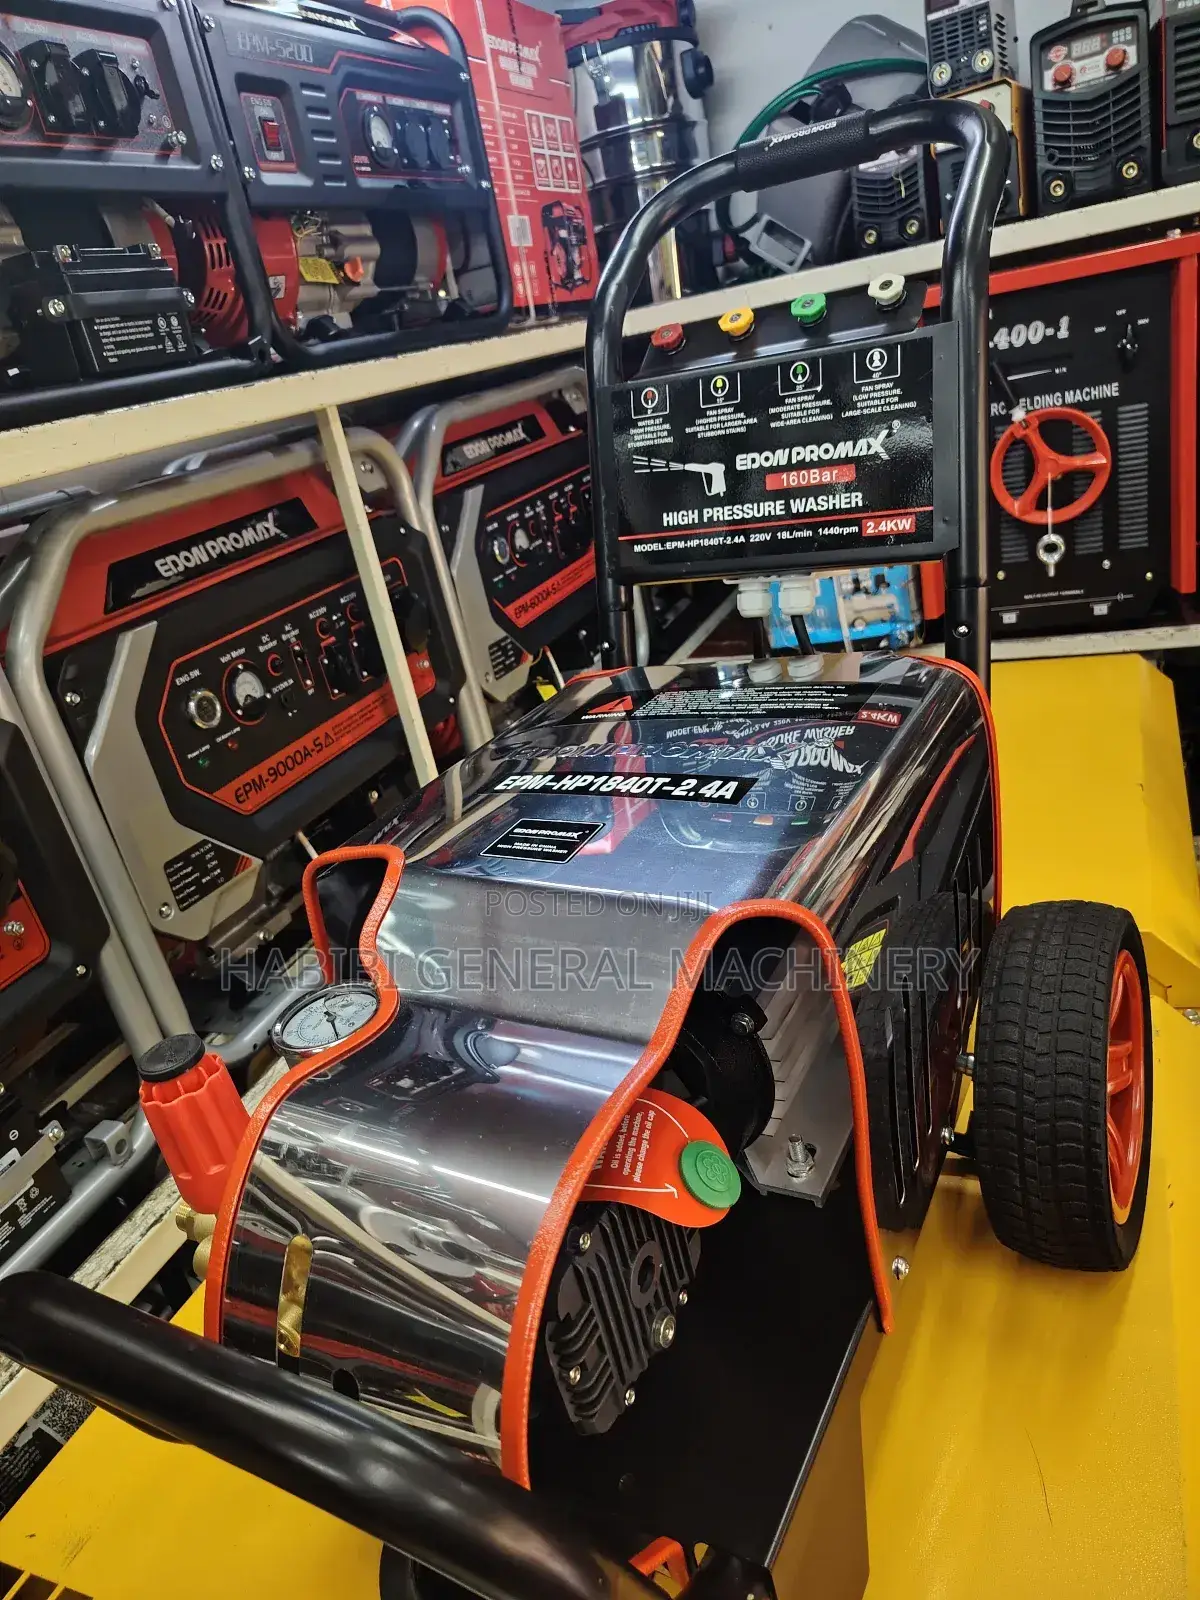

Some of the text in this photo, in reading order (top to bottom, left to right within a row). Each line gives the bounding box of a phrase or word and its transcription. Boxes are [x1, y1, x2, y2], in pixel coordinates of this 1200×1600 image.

[237, 31, 313, 63] EPM-5200
[874, 382, 894, 390] SPRAY
[797, 394, 815, 402] SPRAY
[852, 393, 869, 402] (LOW
[857, 399, 885, 408] SUITABLE
[990, 382, 1120, 417] RC ELDING MACHINE
[717, 407, 734, 415] SPRAY
[768, 403, 801, 414] (MODERATE
[841, 401, 917, 418] LARGE-SCALE CLEANING)
[695, 417, 717, 425] (HIGHER
[770, 414, 833, 428] WIDE-AREA CLEANING)
[781, 411, 807, 419] SUITABLE
[685, 425, 709, 433] SUITABLE
[720, 417, 758, 428] LARGER-AREA
[697, 427, 747, 439] STUBBORN STAINS)
[735, 429, 891, 471] EDON PROMAX
[781, 469, 839, 487] 160Bar
[662, 492, 863, 527] HIGH PRESSURE WASHER
[634, 518, 912, 553] MODEL:EPM-HP1840T-2.4A 220V 18L/min 1440rpm 2.4KW
[154, 511, 288, 578] EDON PROMAX
[261, 633, 271, 643] DC
[220, 647, 246, 664] Volt Meter
[581, 711, 627, 720] WARNING
[494, 775, 739, 800] EPM-HP1840T-2.4A
[648, 1109, 657, 1121] cap
[642, 1131, 650, 1139] the
[628, 1137, 637, 1147] the
[637, 1140, 650, 1161] change
[611, 1159, 619, 1168] Oil
[623, 1147, 636, 1175] operating
